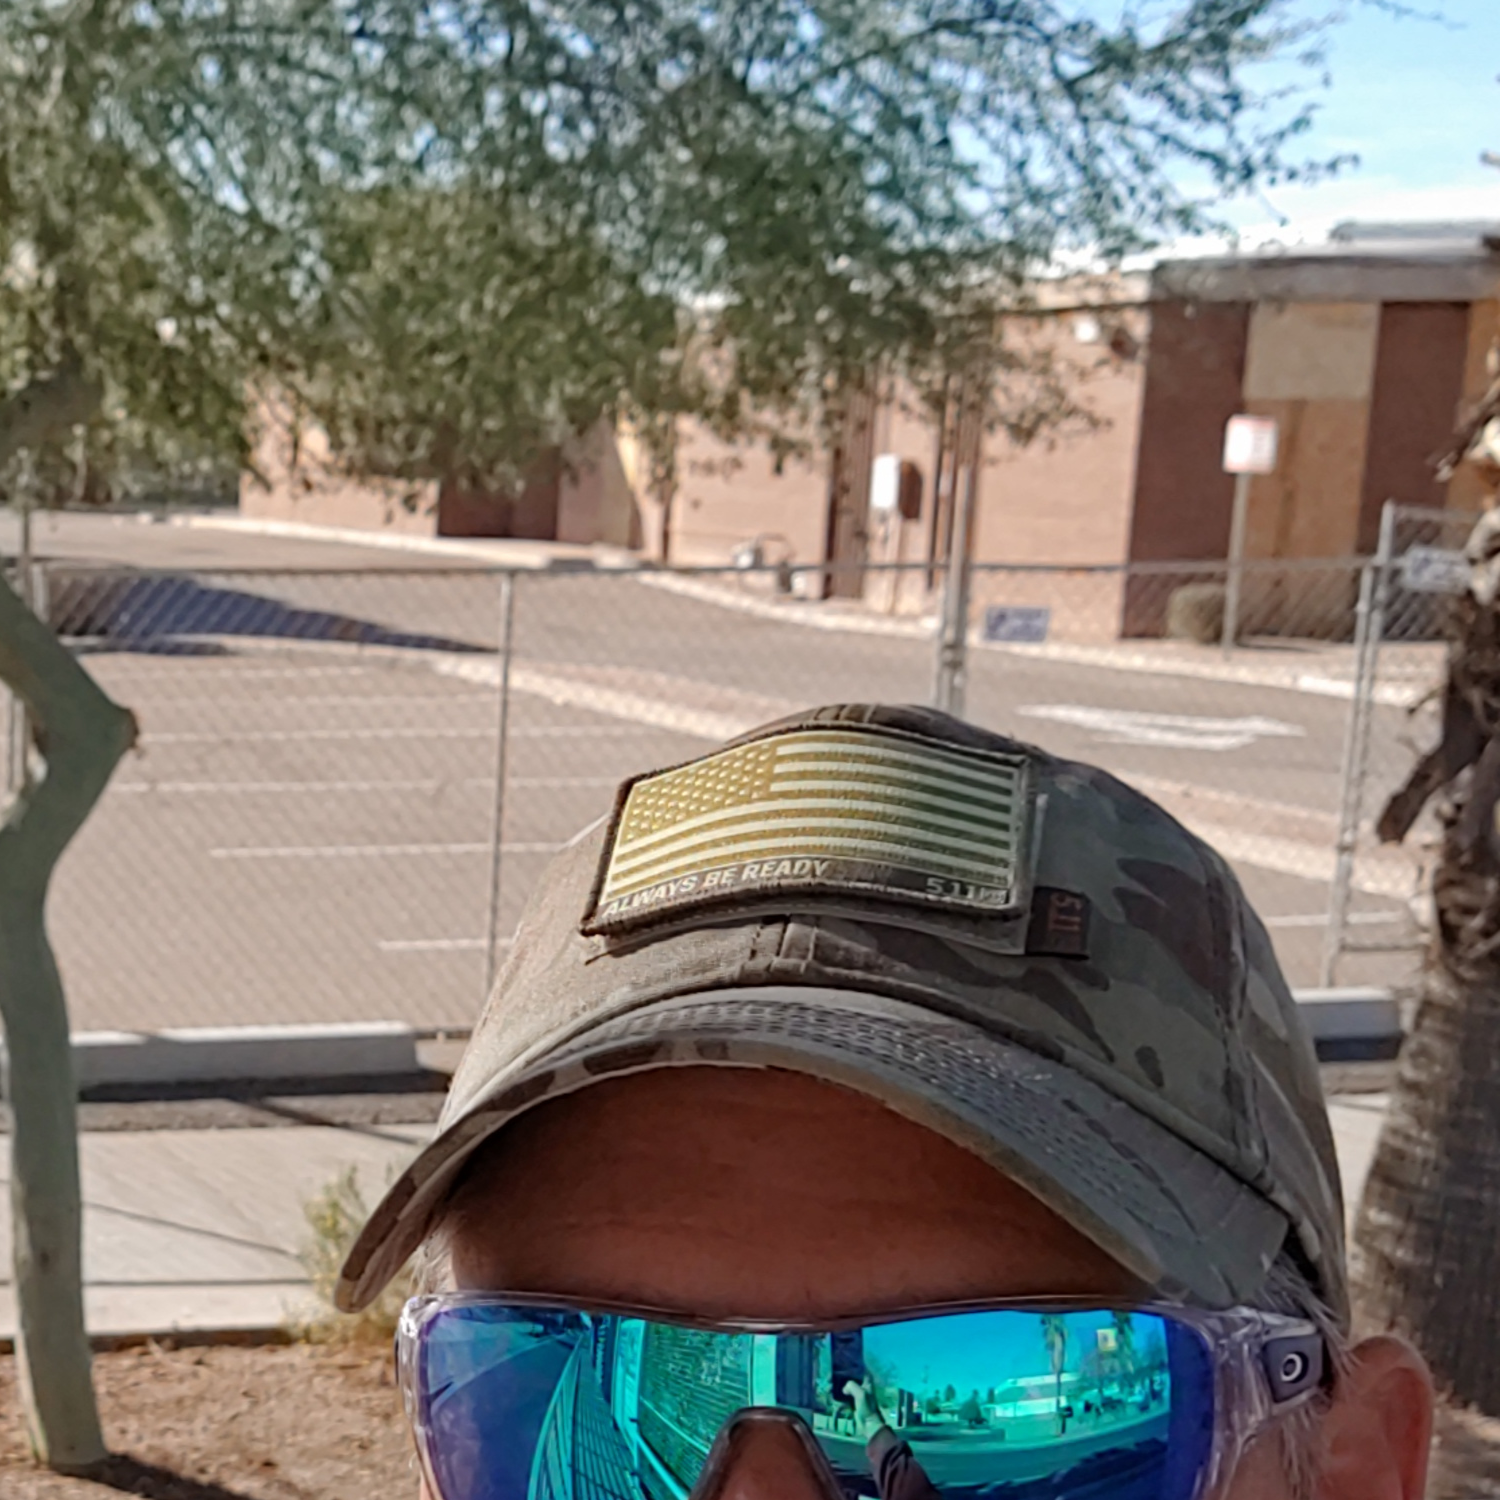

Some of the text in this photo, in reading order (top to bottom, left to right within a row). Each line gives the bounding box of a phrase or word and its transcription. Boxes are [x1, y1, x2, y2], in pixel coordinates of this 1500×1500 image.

[602, 859, 831, 918] ALWAYS BE READY
